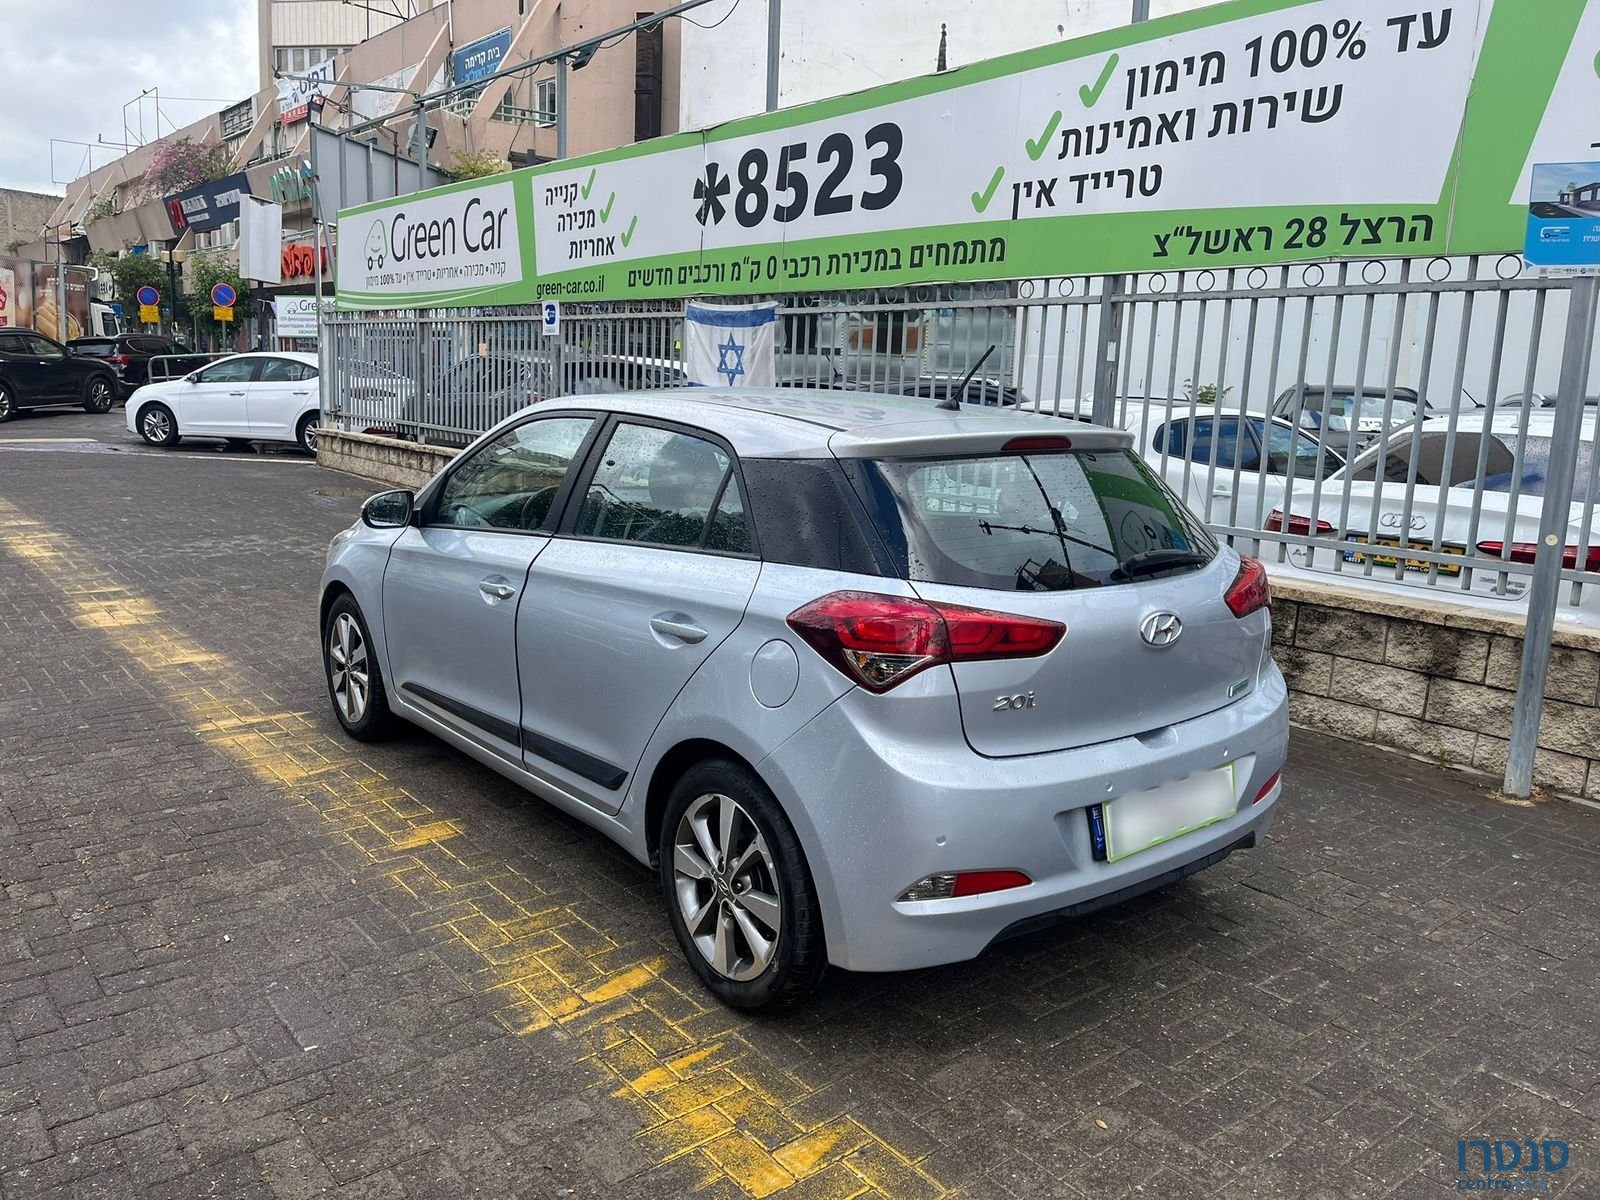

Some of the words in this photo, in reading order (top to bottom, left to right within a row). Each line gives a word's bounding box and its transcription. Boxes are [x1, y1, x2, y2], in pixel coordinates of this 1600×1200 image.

[1386, 8, 1453, 53] עד
[1244, 18, 1367, 78] 100%
[1124, 50, 1226, 110] מימון
[1206, 84, 1344, 138] שירות
[1057, 107, 1195, 160] ואמינות
[545, 182, 578, 208] קנייה
[1012, 177, 1058, 220] אין
[1068, 163, 1163, 204] טרייד
[390, 212, 456, 262] Green
[463, 197, 508, 252] Car
[557, 208, 596, 232] מכירה
[1283, 216, 1328, 249] 28
[1340, 212, 1434, 246] הרצל
[568, 236, 615, 260] אחריות
[826, 248, 902, 276] במכירת
[909, 237, 1006, 269] מתמחים
[380, 273, 395, 285] 100%
[627, 266, 673, 287] חדשים
[678, 262, 725, 285] ורכבים
[783, 256, 820, 279] רכבי
[536, 275, 605, 299] green-car.co.il
[993, 690, 1036, 711] 20i
